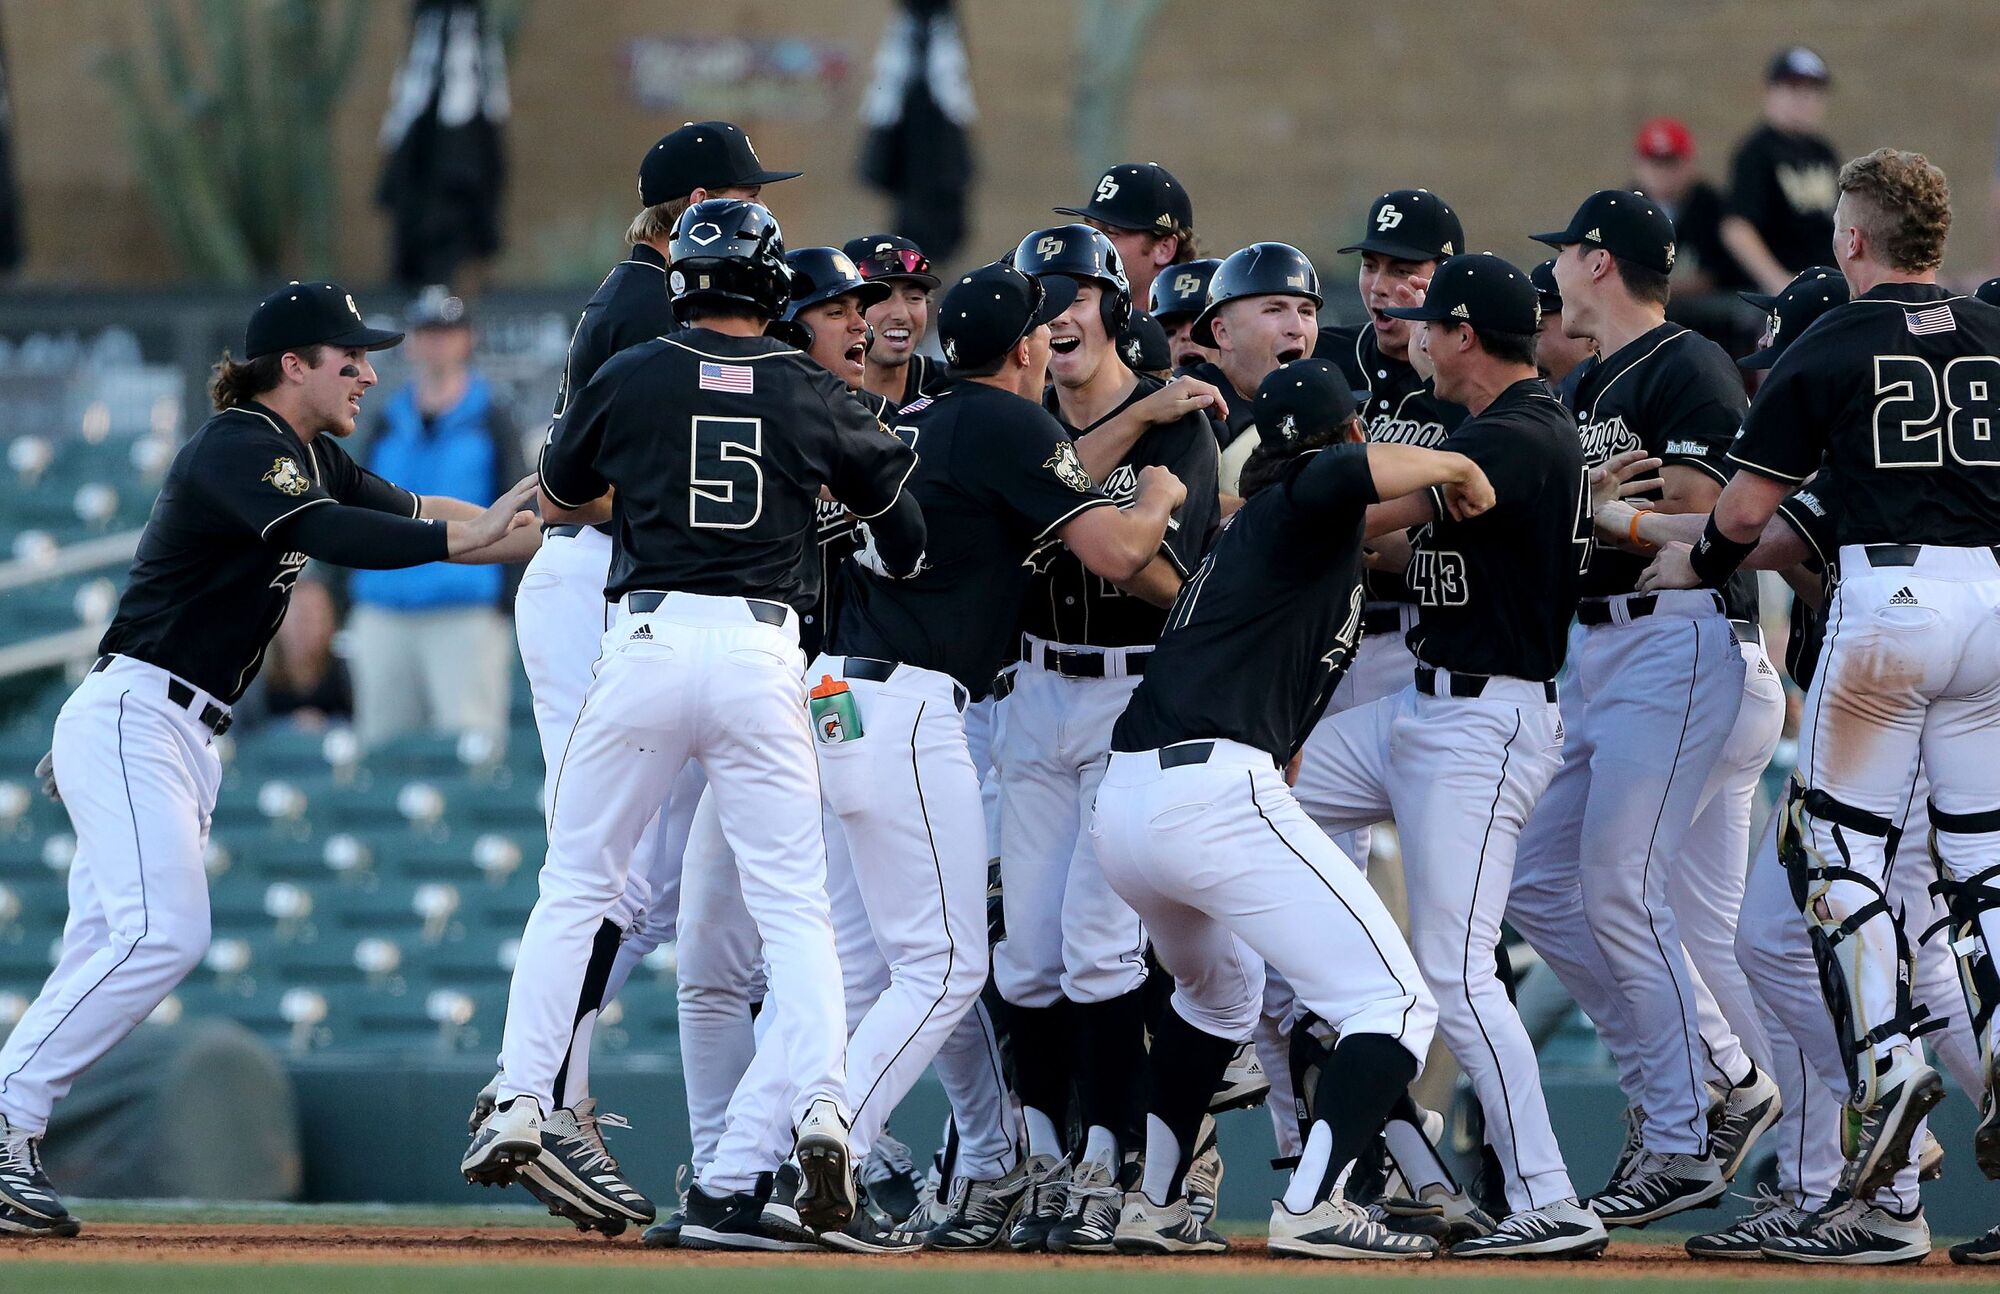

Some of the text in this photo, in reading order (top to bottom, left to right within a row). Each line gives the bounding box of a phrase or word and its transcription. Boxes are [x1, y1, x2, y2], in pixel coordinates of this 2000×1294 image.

[1096, 174, 1120, 203] CP
[1376, 204, 1404, 232] CP
[1036, 236, 1064, 262] CP
[1174, 273, 1201, 299] CP
[1872, 355, 2000, 469] 28
[689, 415, 764, 530] 5
[1413, 549, 1470, 607] 43
[1889, 597, 1919, 605] adidas
[629, 633, 654, 641] adidas
